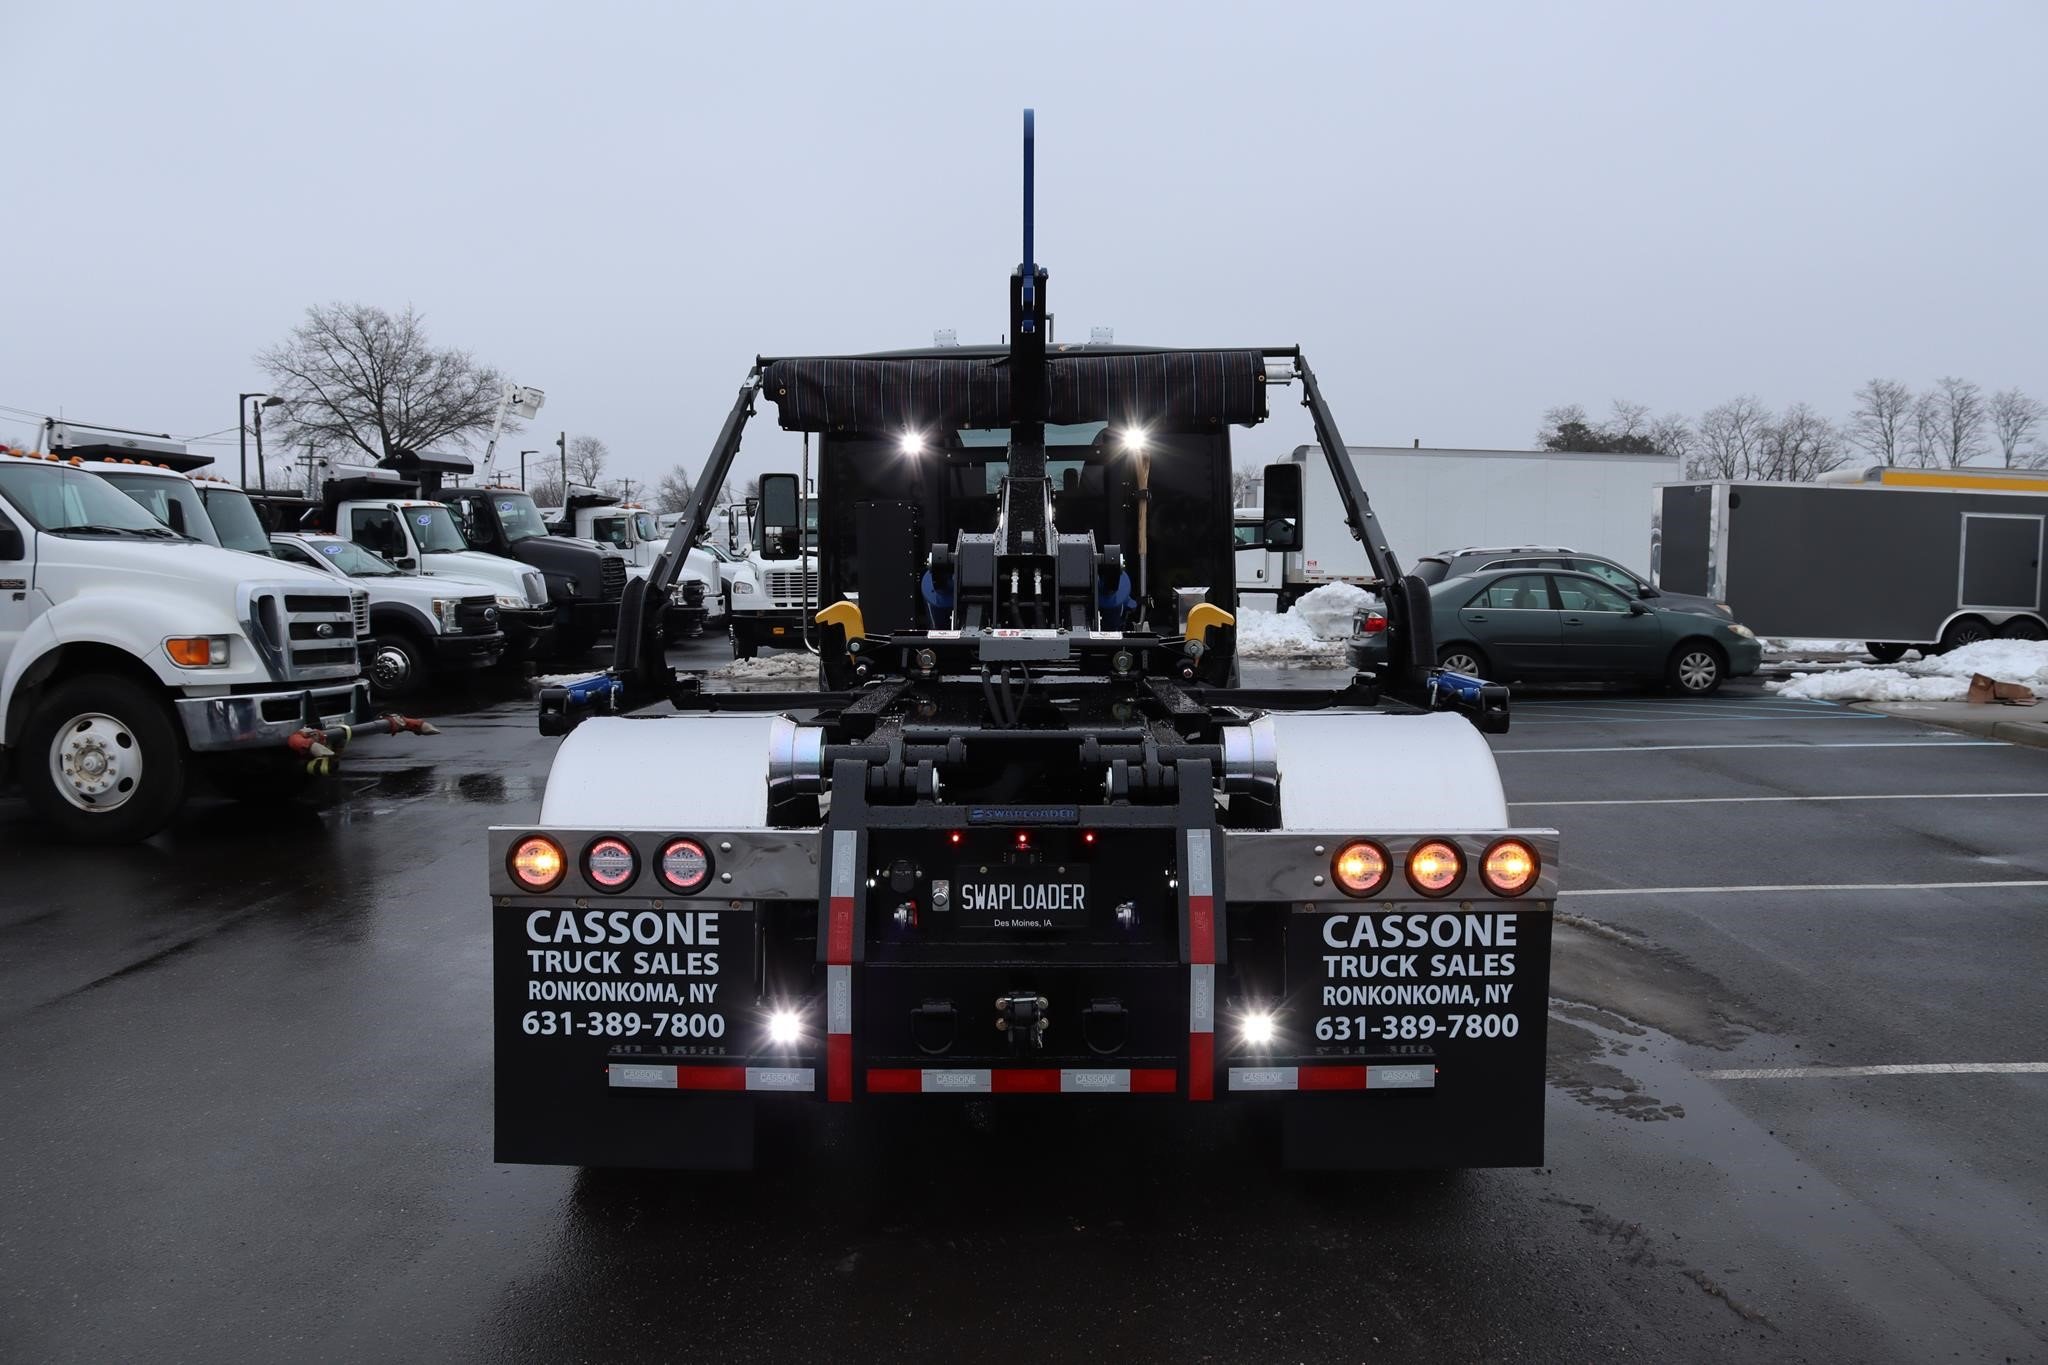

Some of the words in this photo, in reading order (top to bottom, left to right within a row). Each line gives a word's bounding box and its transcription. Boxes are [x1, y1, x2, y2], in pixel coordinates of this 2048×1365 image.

[985, 808, 1074, 818] SWAPLOADER
[961, 883, 1085, 910] SWAPLOADER
[526, 910, 720, 945] CASSONE
[994, 919, 1009, 927] Des
[1011, 919, 1041, 929] Moines,
[1043, 919, 1053, 927] IA
[1322, 913, 1518, 948] CASSONE
[526, 950, 621, 974] TRUCK
[633, 951, 720, 976] SALES
[1322, 955, 1418, 978] TRUCK
[1430, 953, 1516, 977] SALES
[528, 981, 685, 1007] RONKONKOMA,
[689, 983, 718, 1004] NY
[1322, 984, 1480, 1008] RONKONKOMA,
[1485, 983, 1514, 1004] NY
[522, 1010, 725, 1038] 631-389-7800
[1315, 1013, 1519, 1041] 631-389-7800
[623, 1068, 663, 1081] CASSONE
[936, 1073, 977, 1085] CASSONE
[1075, 1073, 1116, 1085] CASSONE
[1381, 1069, 1421, 1081] CASSONE
